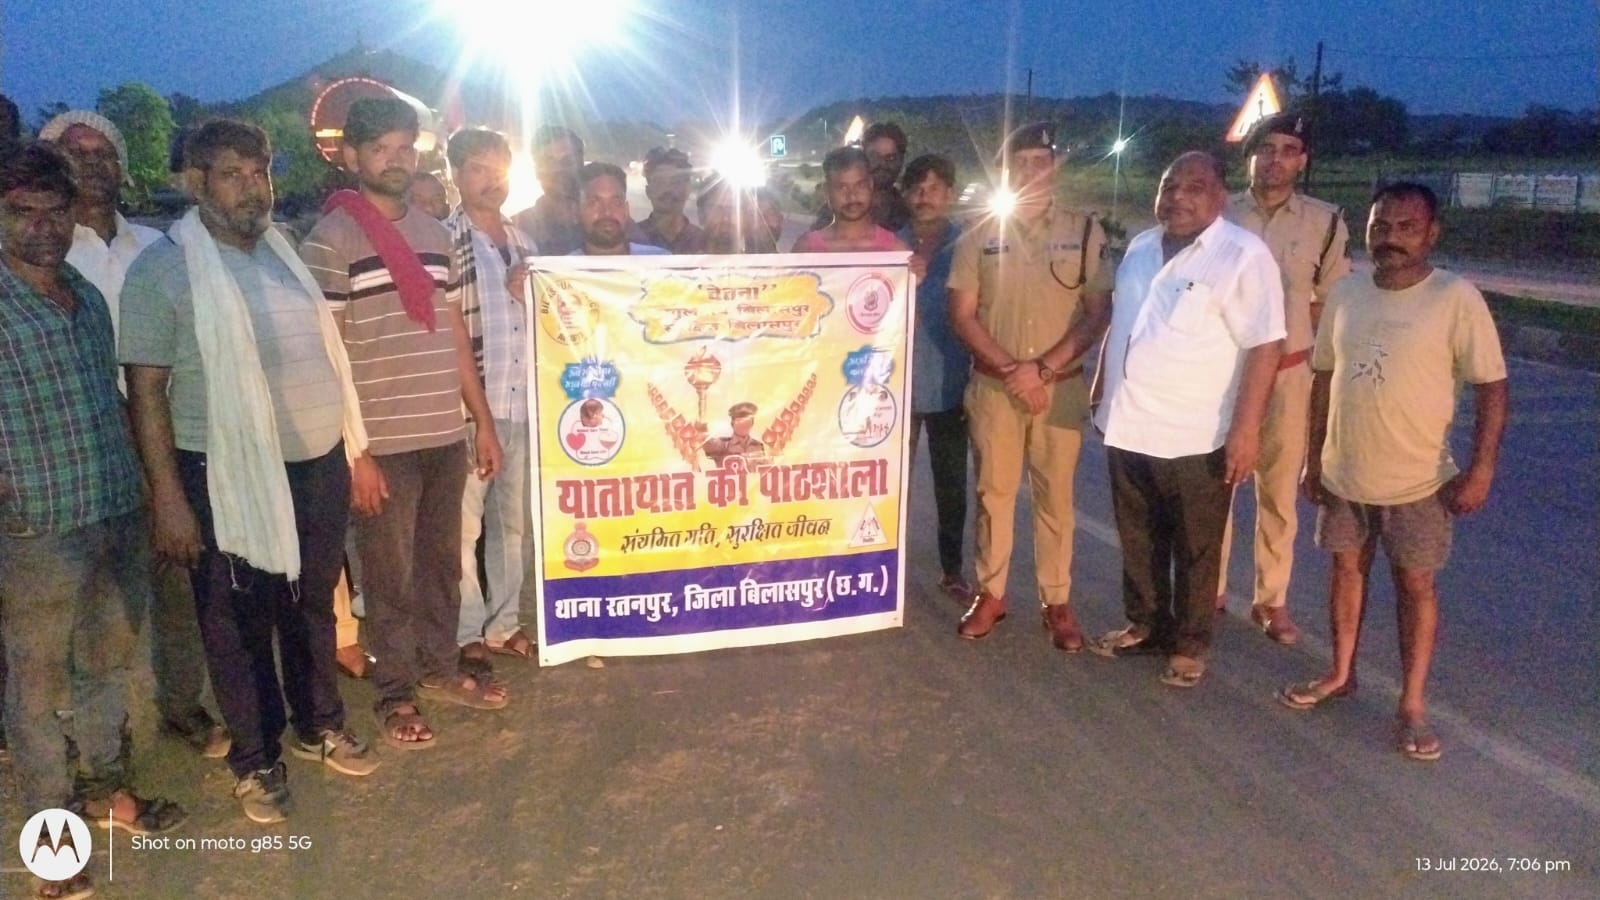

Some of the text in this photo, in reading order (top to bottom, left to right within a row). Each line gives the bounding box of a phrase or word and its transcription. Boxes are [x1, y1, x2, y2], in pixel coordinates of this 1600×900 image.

[556, 455, 888, 519] यातायात की पाठशाला
[620, 526, 683, 553] संयमित
[725, 515, 785, 549] सुरक्षित
[786, 514, 832, 537] जीवन
[555, 597, 602, 619] थाना
[606, 592, 679, 622] रतनपुर,
[684, 584, 736, 611] जिला
